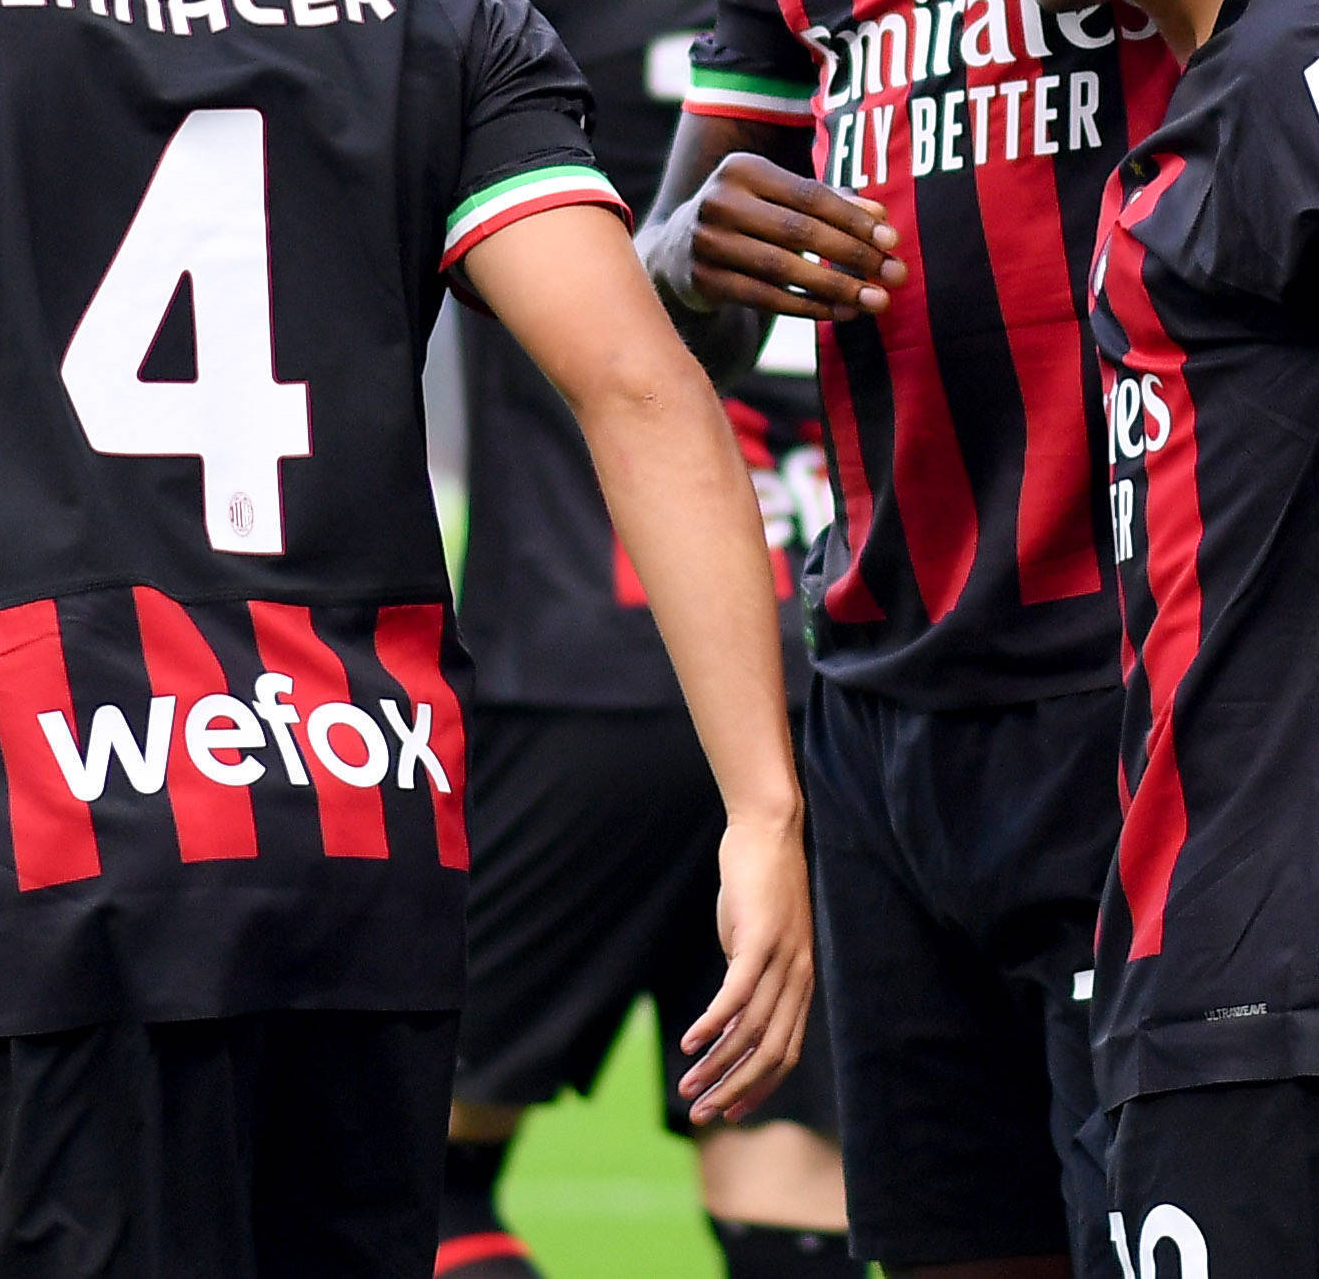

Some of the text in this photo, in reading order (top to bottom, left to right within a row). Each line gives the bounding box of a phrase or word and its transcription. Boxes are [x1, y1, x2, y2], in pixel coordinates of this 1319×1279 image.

[832, 70, 1103, 190] FLY BETTER
[60, 108, 312, 554] 4
[37, 672, 453, 802] wefox
